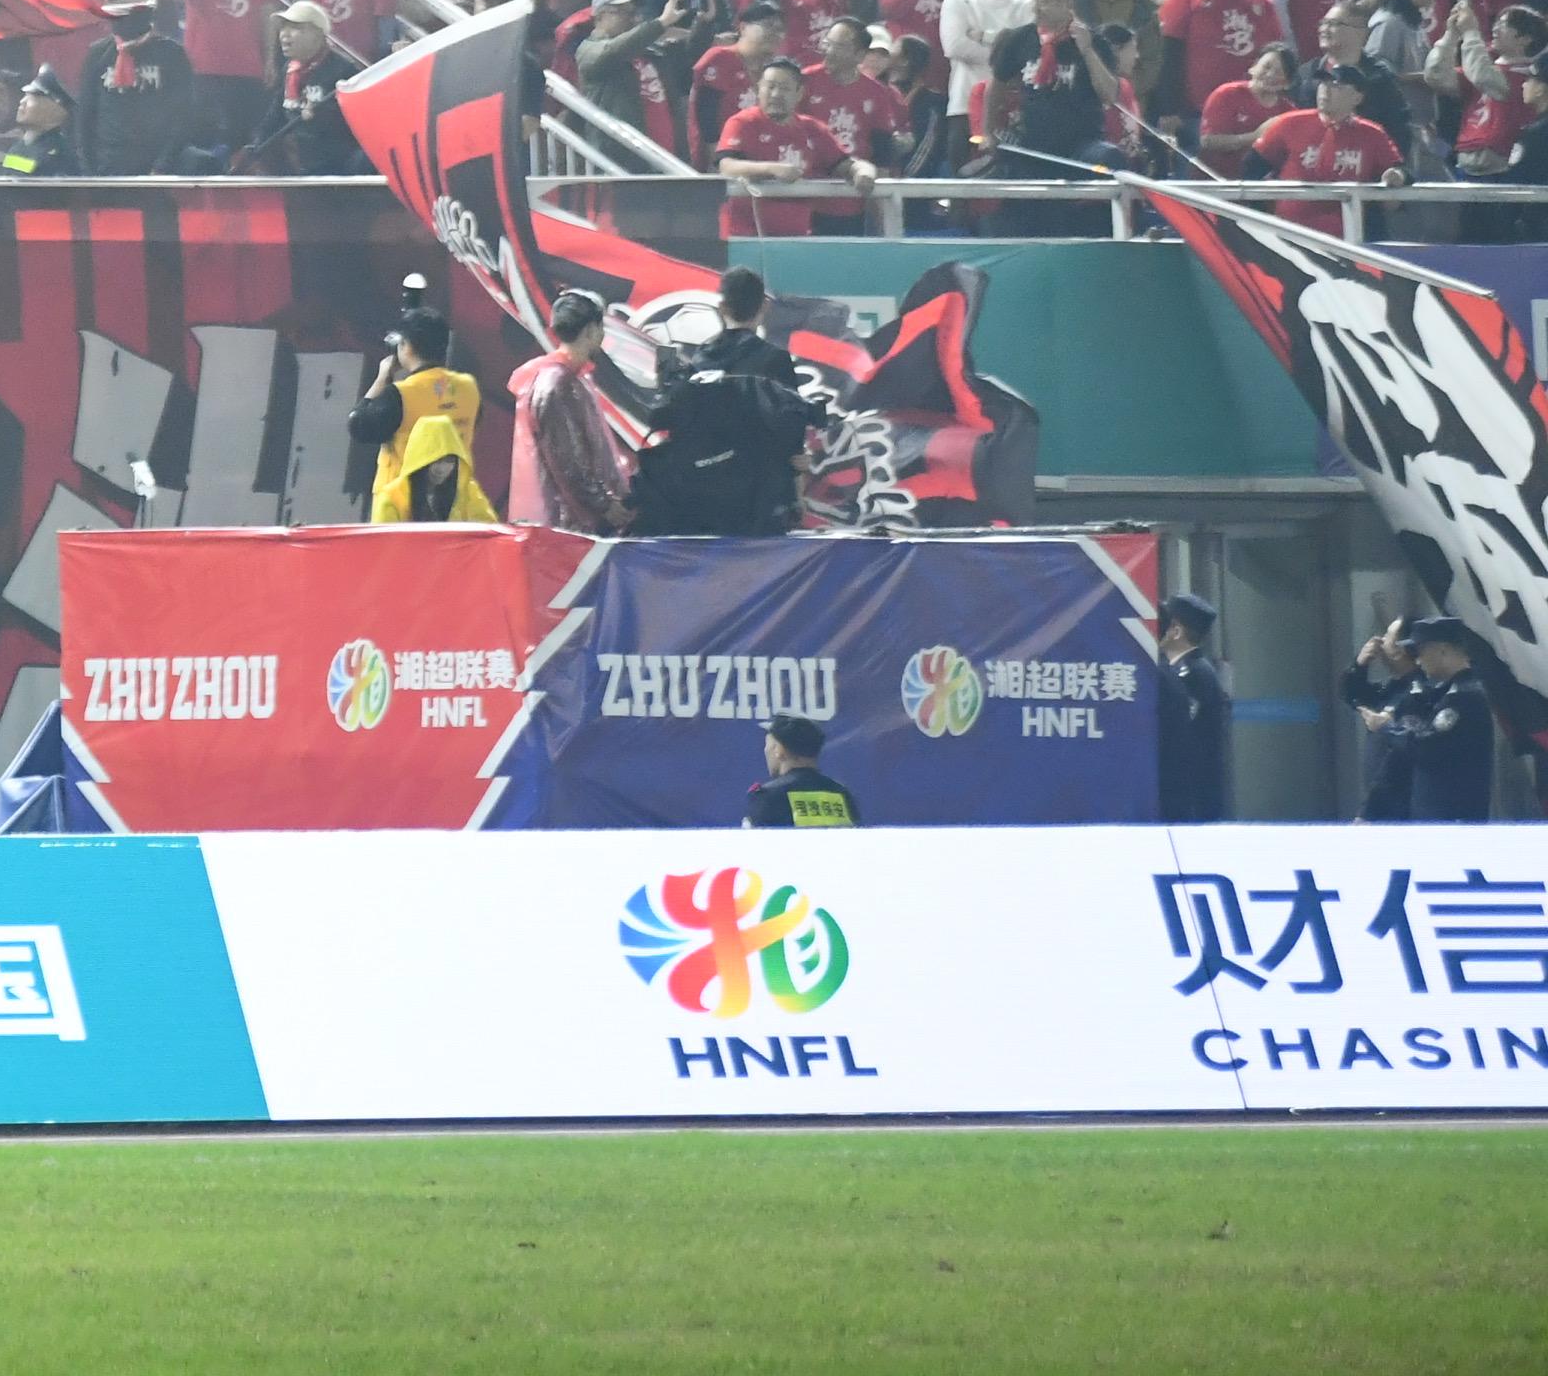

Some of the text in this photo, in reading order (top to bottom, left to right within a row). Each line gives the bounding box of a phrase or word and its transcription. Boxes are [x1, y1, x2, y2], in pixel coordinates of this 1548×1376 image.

[392, 649, 519, 692] 湘超联赛
[986, 659, 1138, 702] 湘超联赛
[420, 693, 488, 729] HNFL
[1020, 706, 1104, 739] HNFL
[1152, 868, 1548, 996] 财信
[668, 1035, 879, 1080] HNFL
